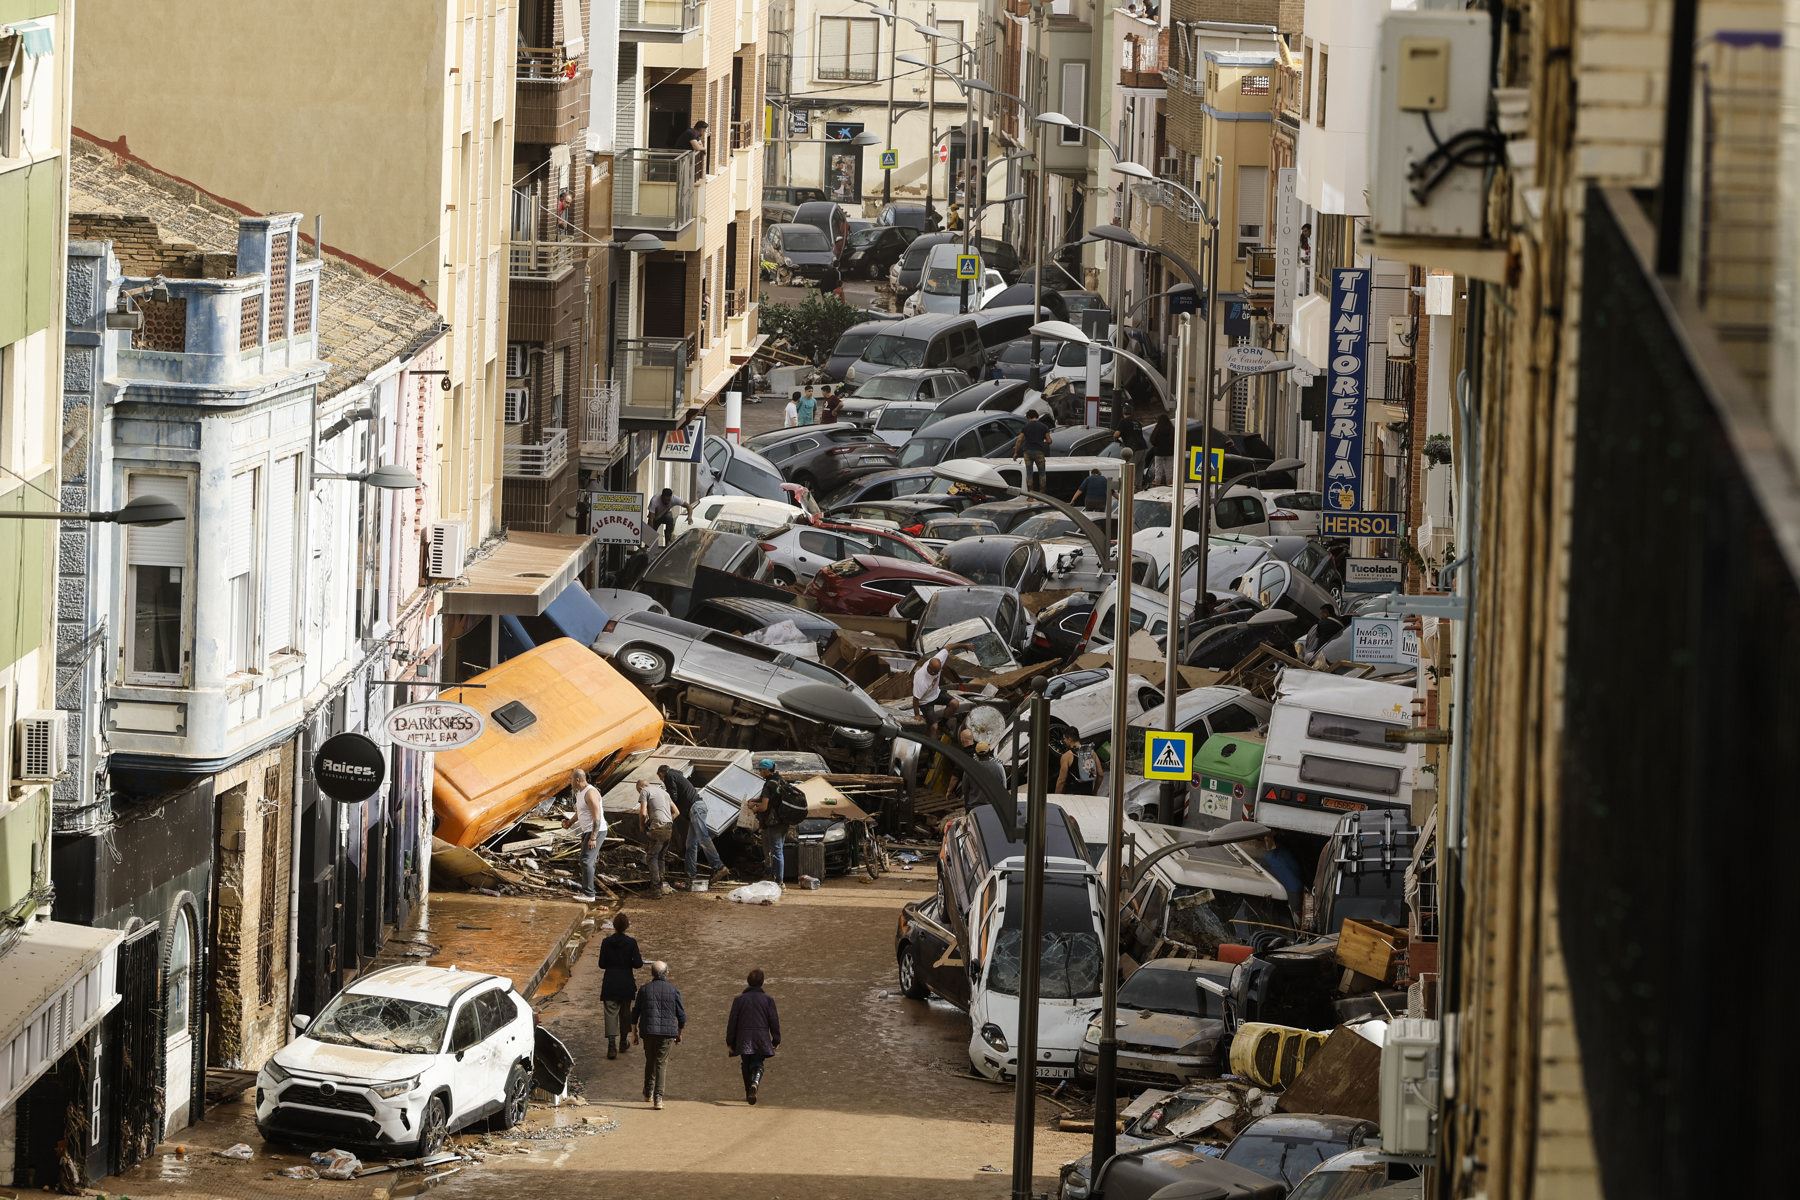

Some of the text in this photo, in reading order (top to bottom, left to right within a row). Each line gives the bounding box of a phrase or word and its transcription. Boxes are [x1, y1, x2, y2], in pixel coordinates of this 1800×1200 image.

[1283, 174, 1293, 235] EMILIO
[1237, 347, 1263, 356] FORN
[1328, 272, 1363, 479] TINTORERIA
[666, 444, 690, 452] FIATC
[592, 515, 640, 536] GUERRERO
[1324, 516, 1395, 534] HERSOL
[1350, 564, 1398, 574] Tucolada
[1356, 627, 1377, 636] INMO
[1402, 636, 1418, 654] INM
[394, 717, 473, 731] DARKNESS
[407, 732, 458, 742] METAL BAR
[323, 759, 371, 776] Raices
